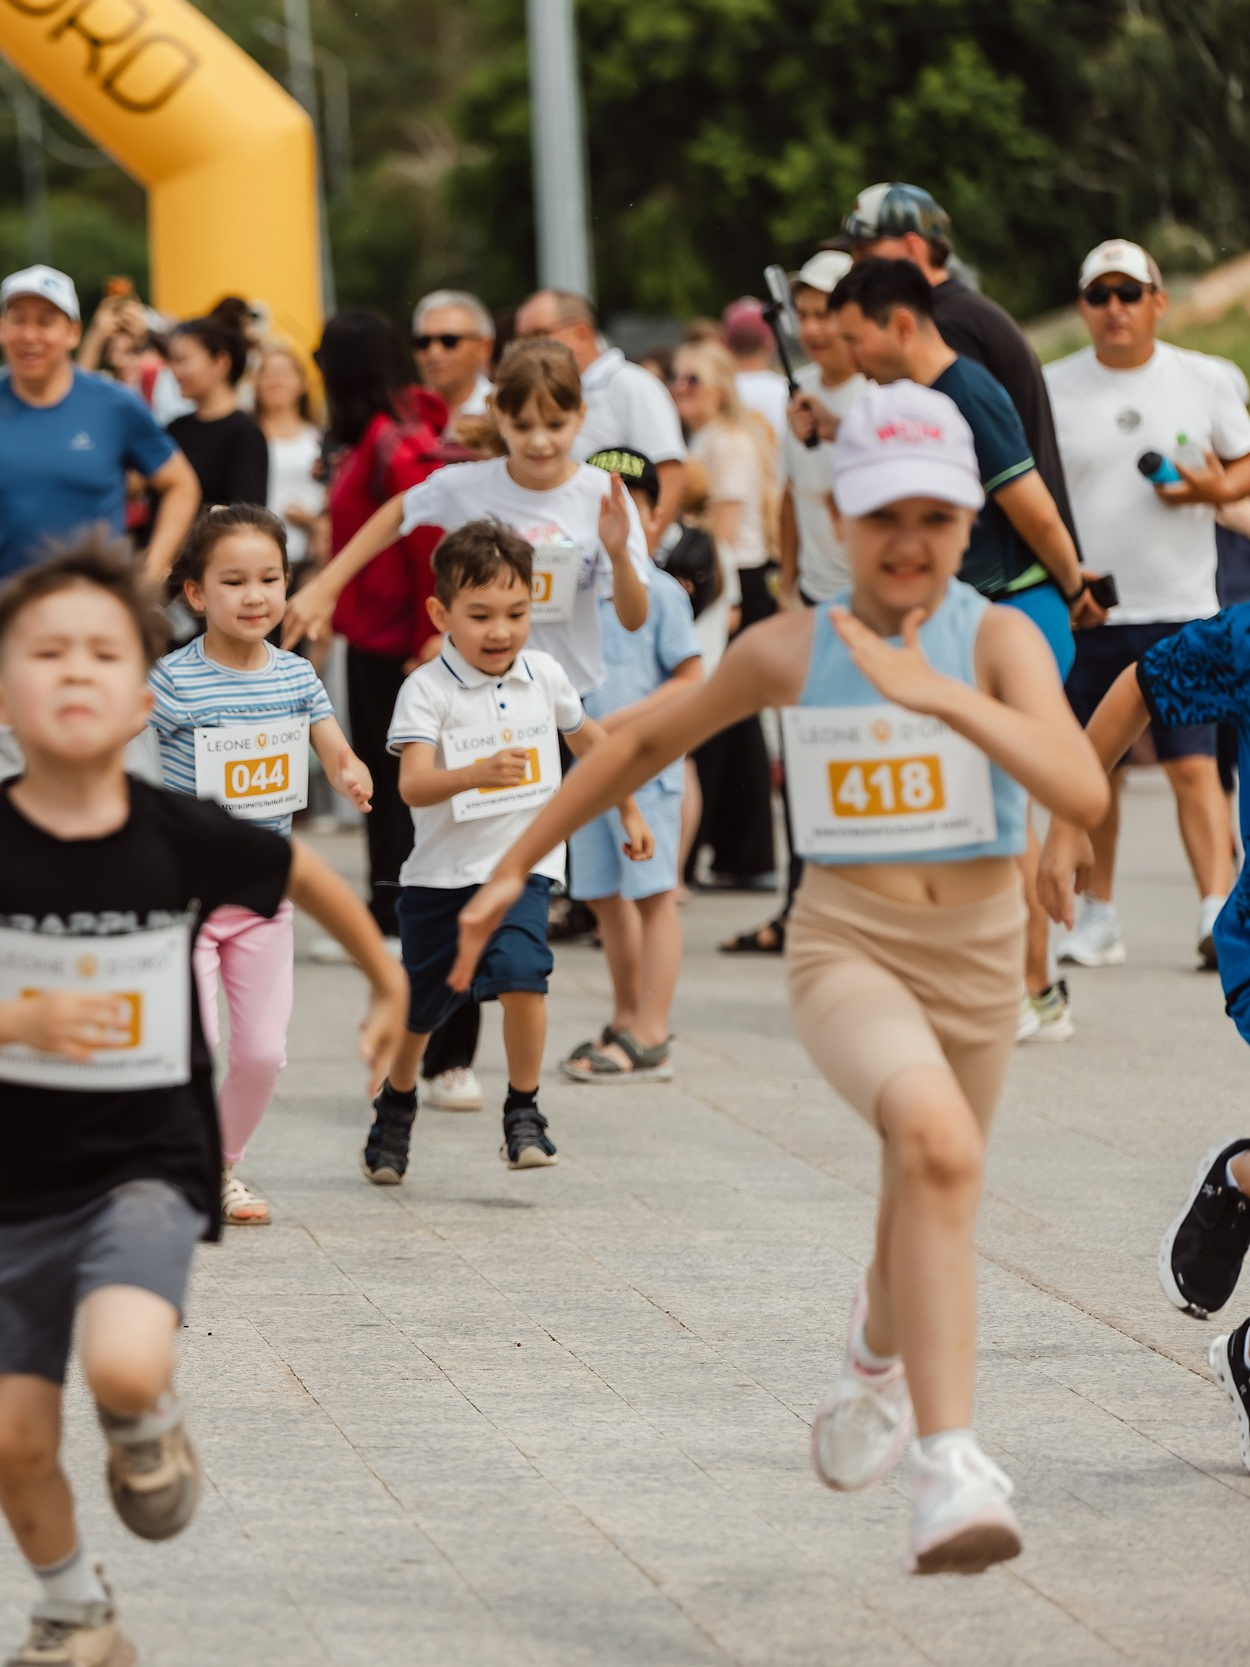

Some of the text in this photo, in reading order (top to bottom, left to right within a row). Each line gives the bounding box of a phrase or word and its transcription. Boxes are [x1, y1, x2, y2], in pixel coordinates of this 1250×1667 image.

[6, 0, 202, 115] RO
[207, 738, 252, 753] LEONE
[454, 734, 497, 752] LEONE
[231, 758, 286, 794] 044
[837, 760, 935, 813] 418
